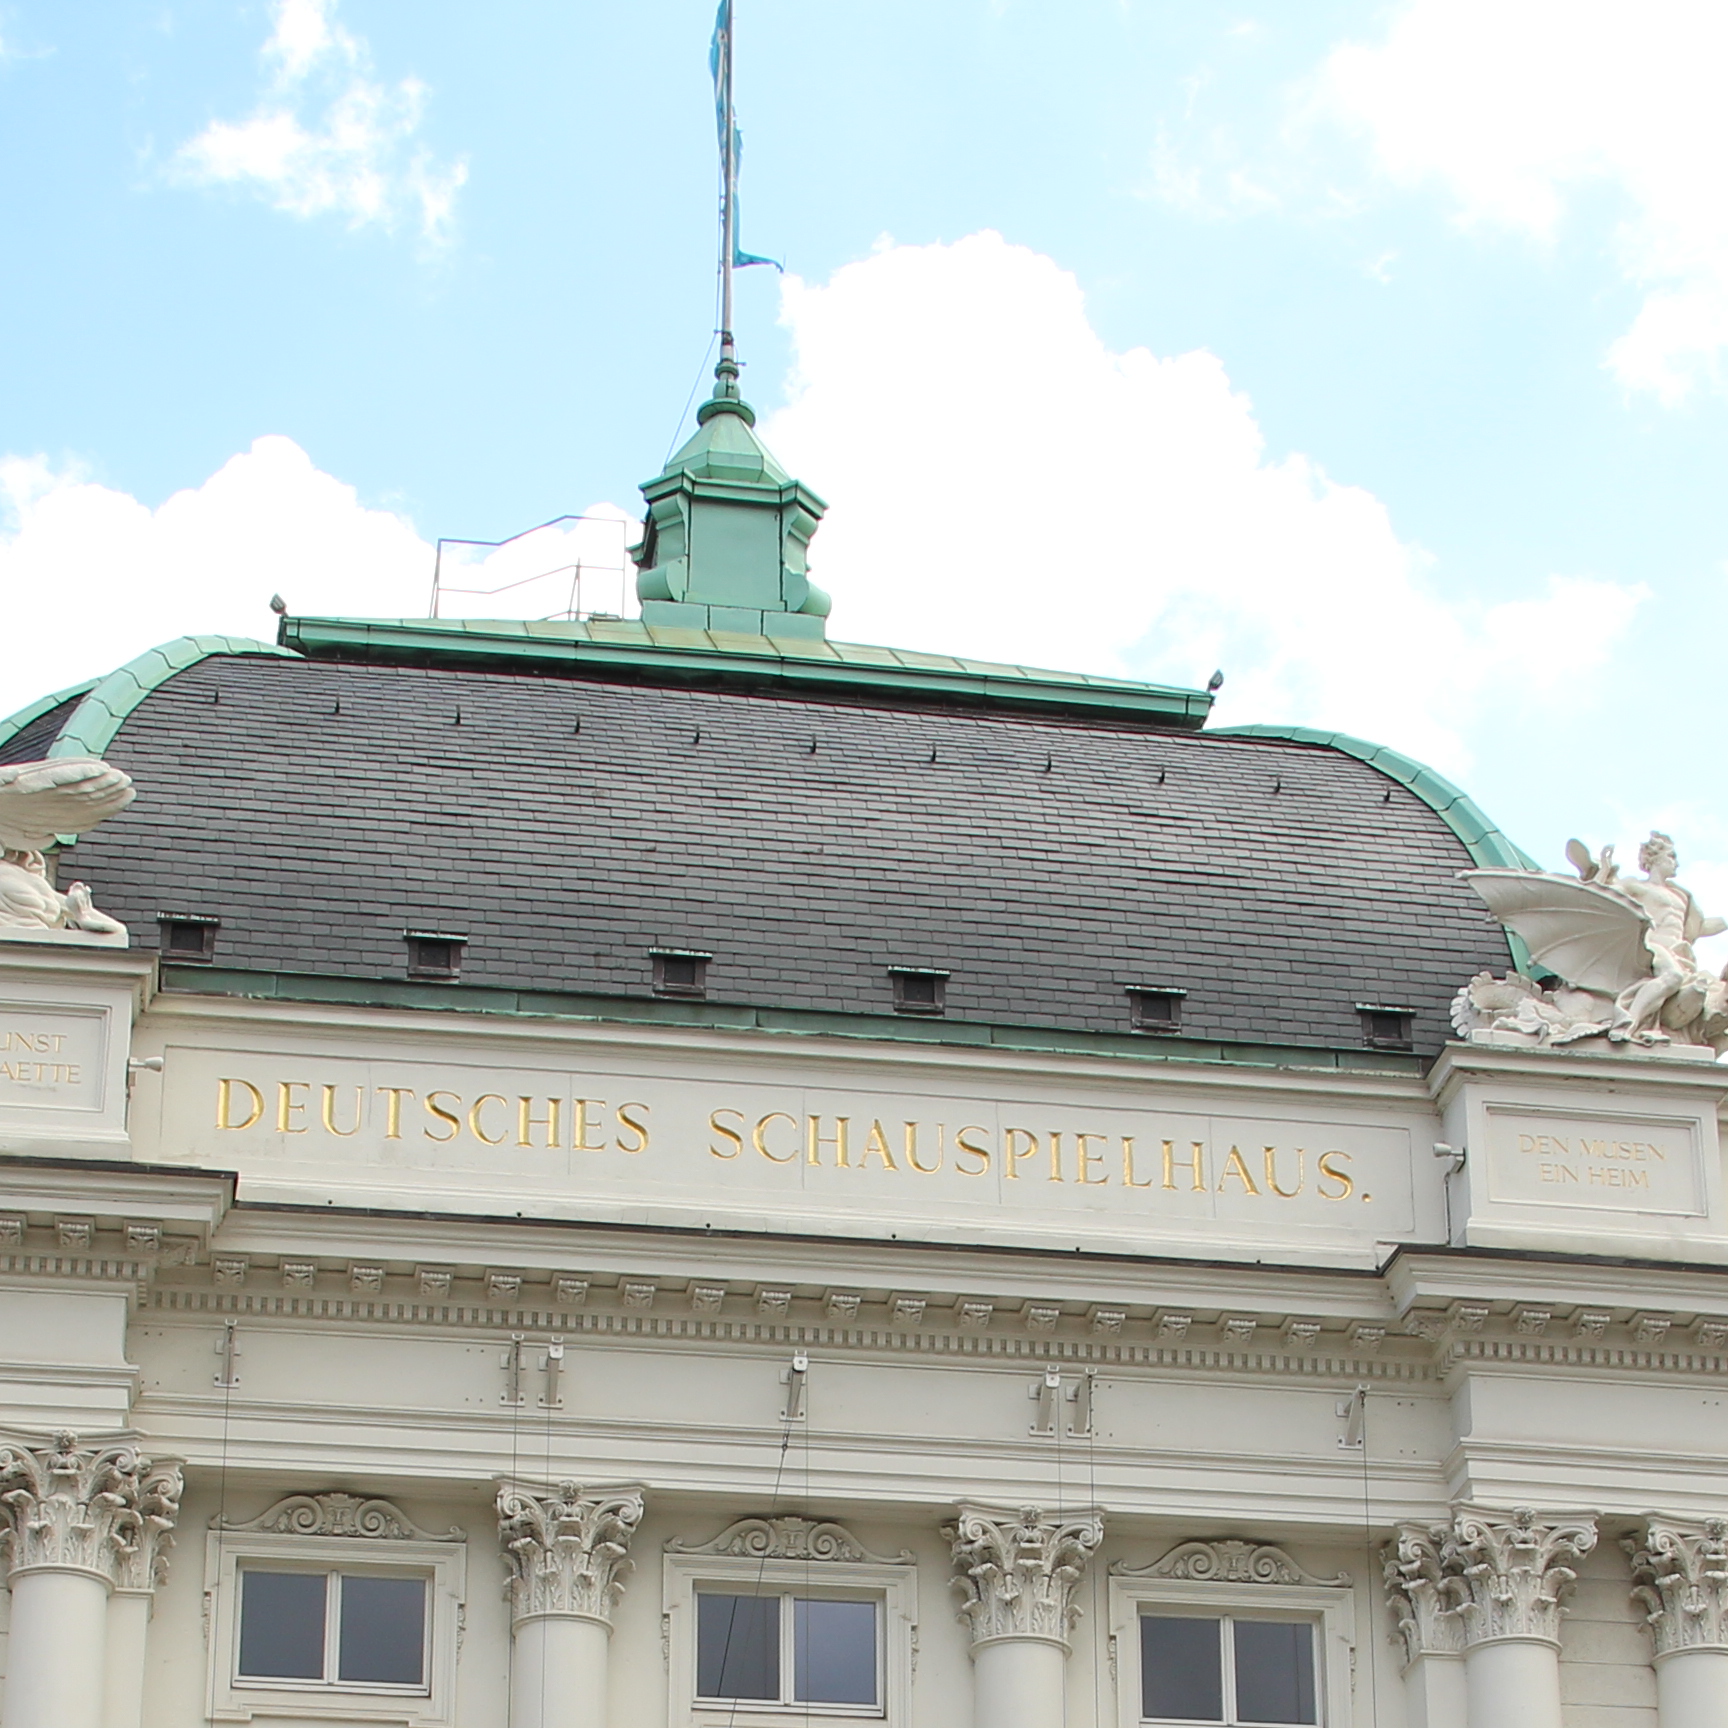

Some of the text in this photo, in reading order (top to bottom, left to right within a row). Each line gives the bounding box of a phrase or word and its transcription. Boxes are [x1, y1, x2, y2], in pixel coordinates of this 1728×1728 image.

[214, 1077, 1373, 1203] DEUTSCHES SCHAUSPIELHAUS.
[1518, 1133, 1667, 1162] DEN MUSEN
[1540, 1163, 1649, 1189] EIN HEIM
